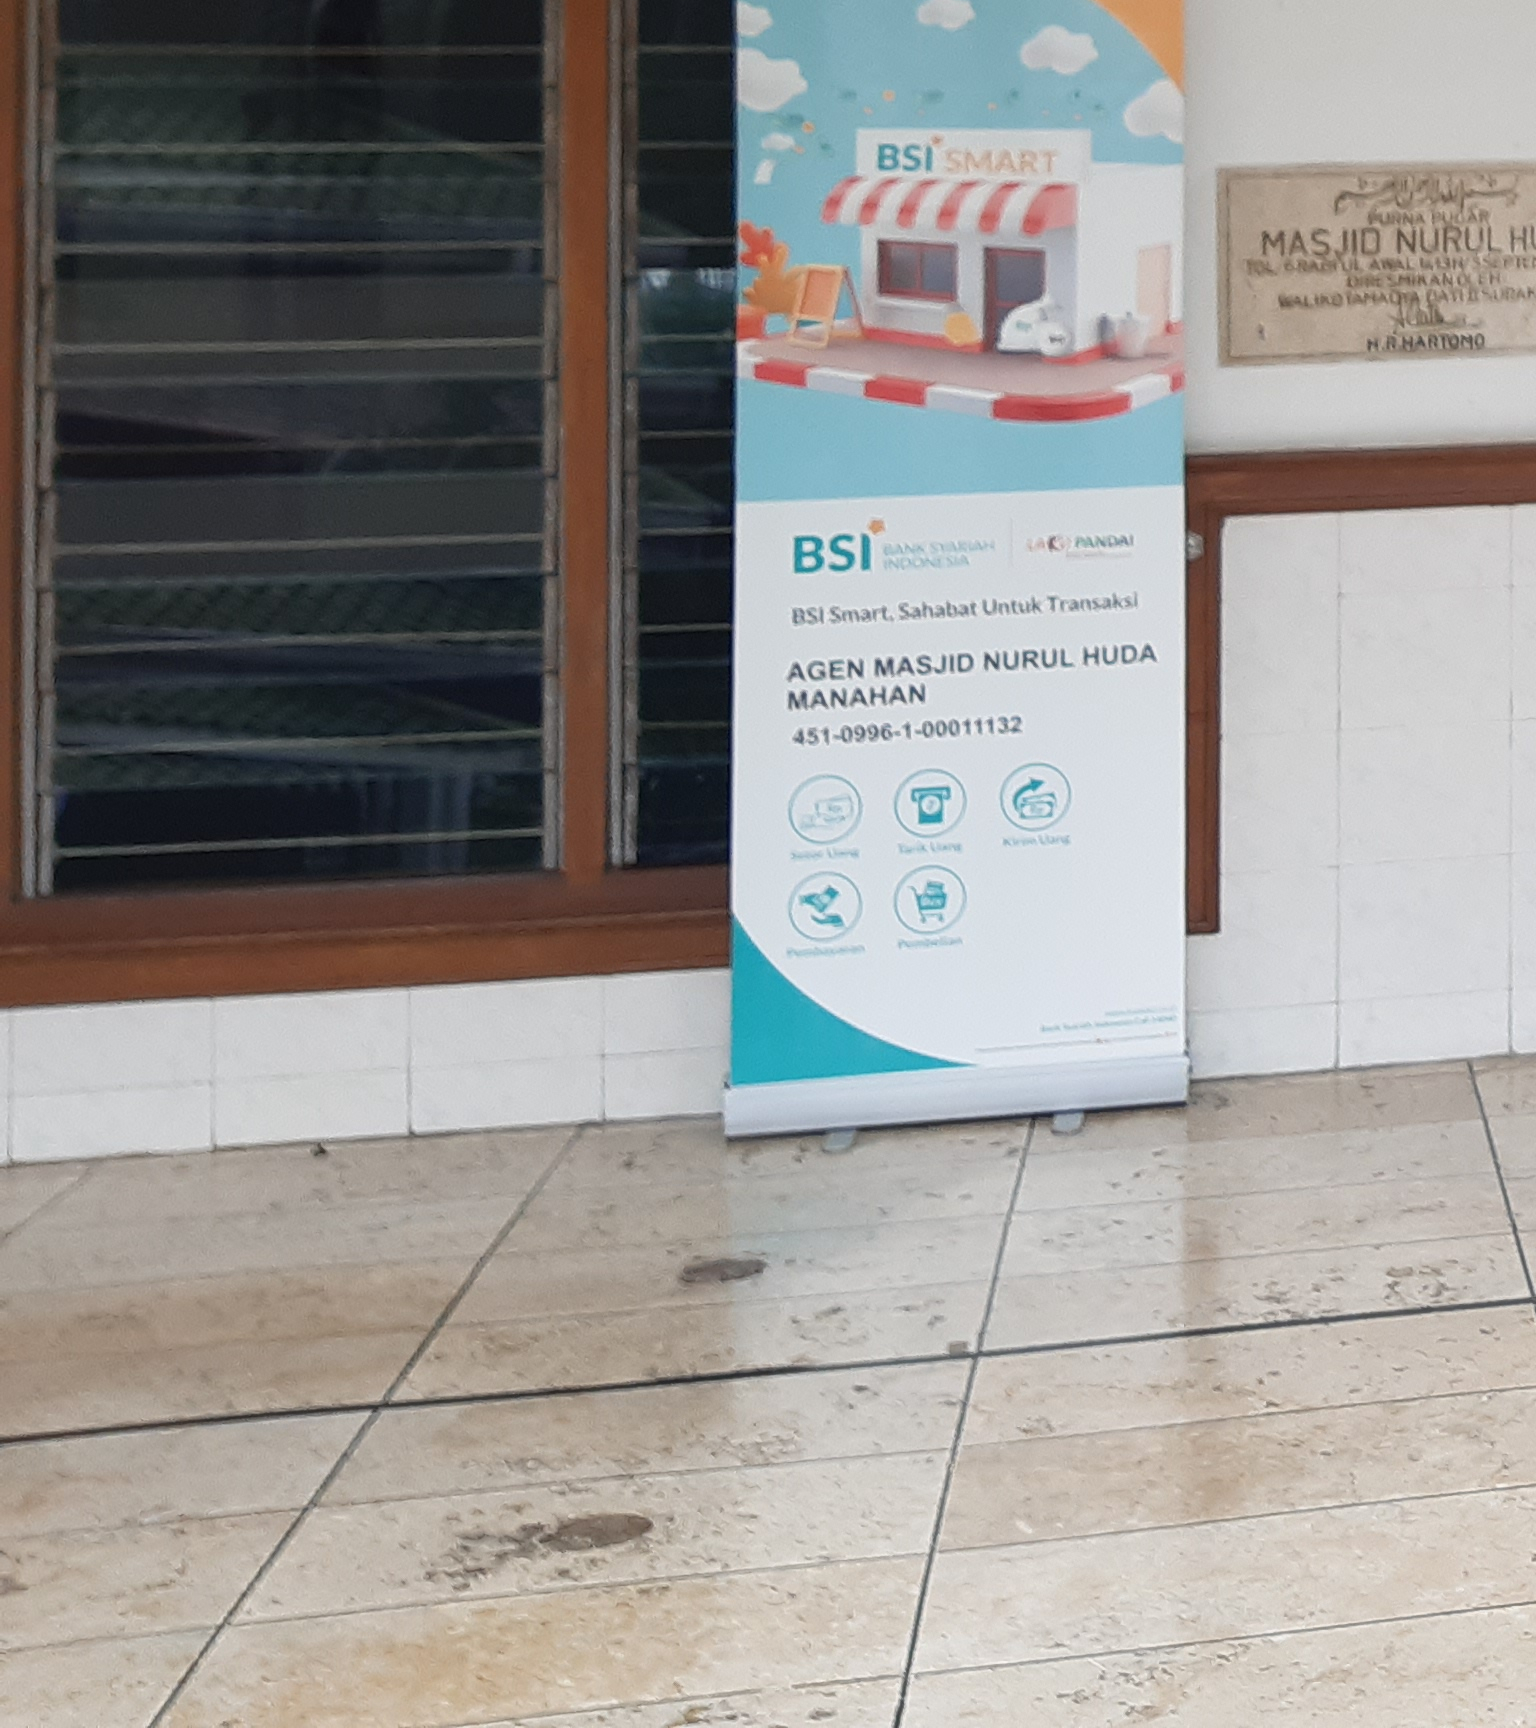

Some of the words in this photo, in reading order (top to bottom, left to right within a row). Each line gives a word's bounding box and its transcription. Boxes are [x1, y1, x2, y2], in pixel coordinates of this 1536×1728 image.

[876, 143, 933, 173] BSI
[945, 148, 1059, 174] SMART
[1261, 227, 1381, 257] MASJID
[1396, 225, 1502, 254] NURUL
[792, 533, 873, 574] BSI
[791, 607, 824, 625] BSI
[898, 601, 977, 621] Sahabat
[982, 595, 1043, 616] Untuk
[1046, 591, 1138, 613] Transaksi
[786, 658, 864, 682] AGEN
[874, 652, 975, 678] MASJID
[983, 647, 1075, 672] NURUL
[1082, 642, 1158, 667] HUDA
[787, 683, 926, 711] MANAHAN
